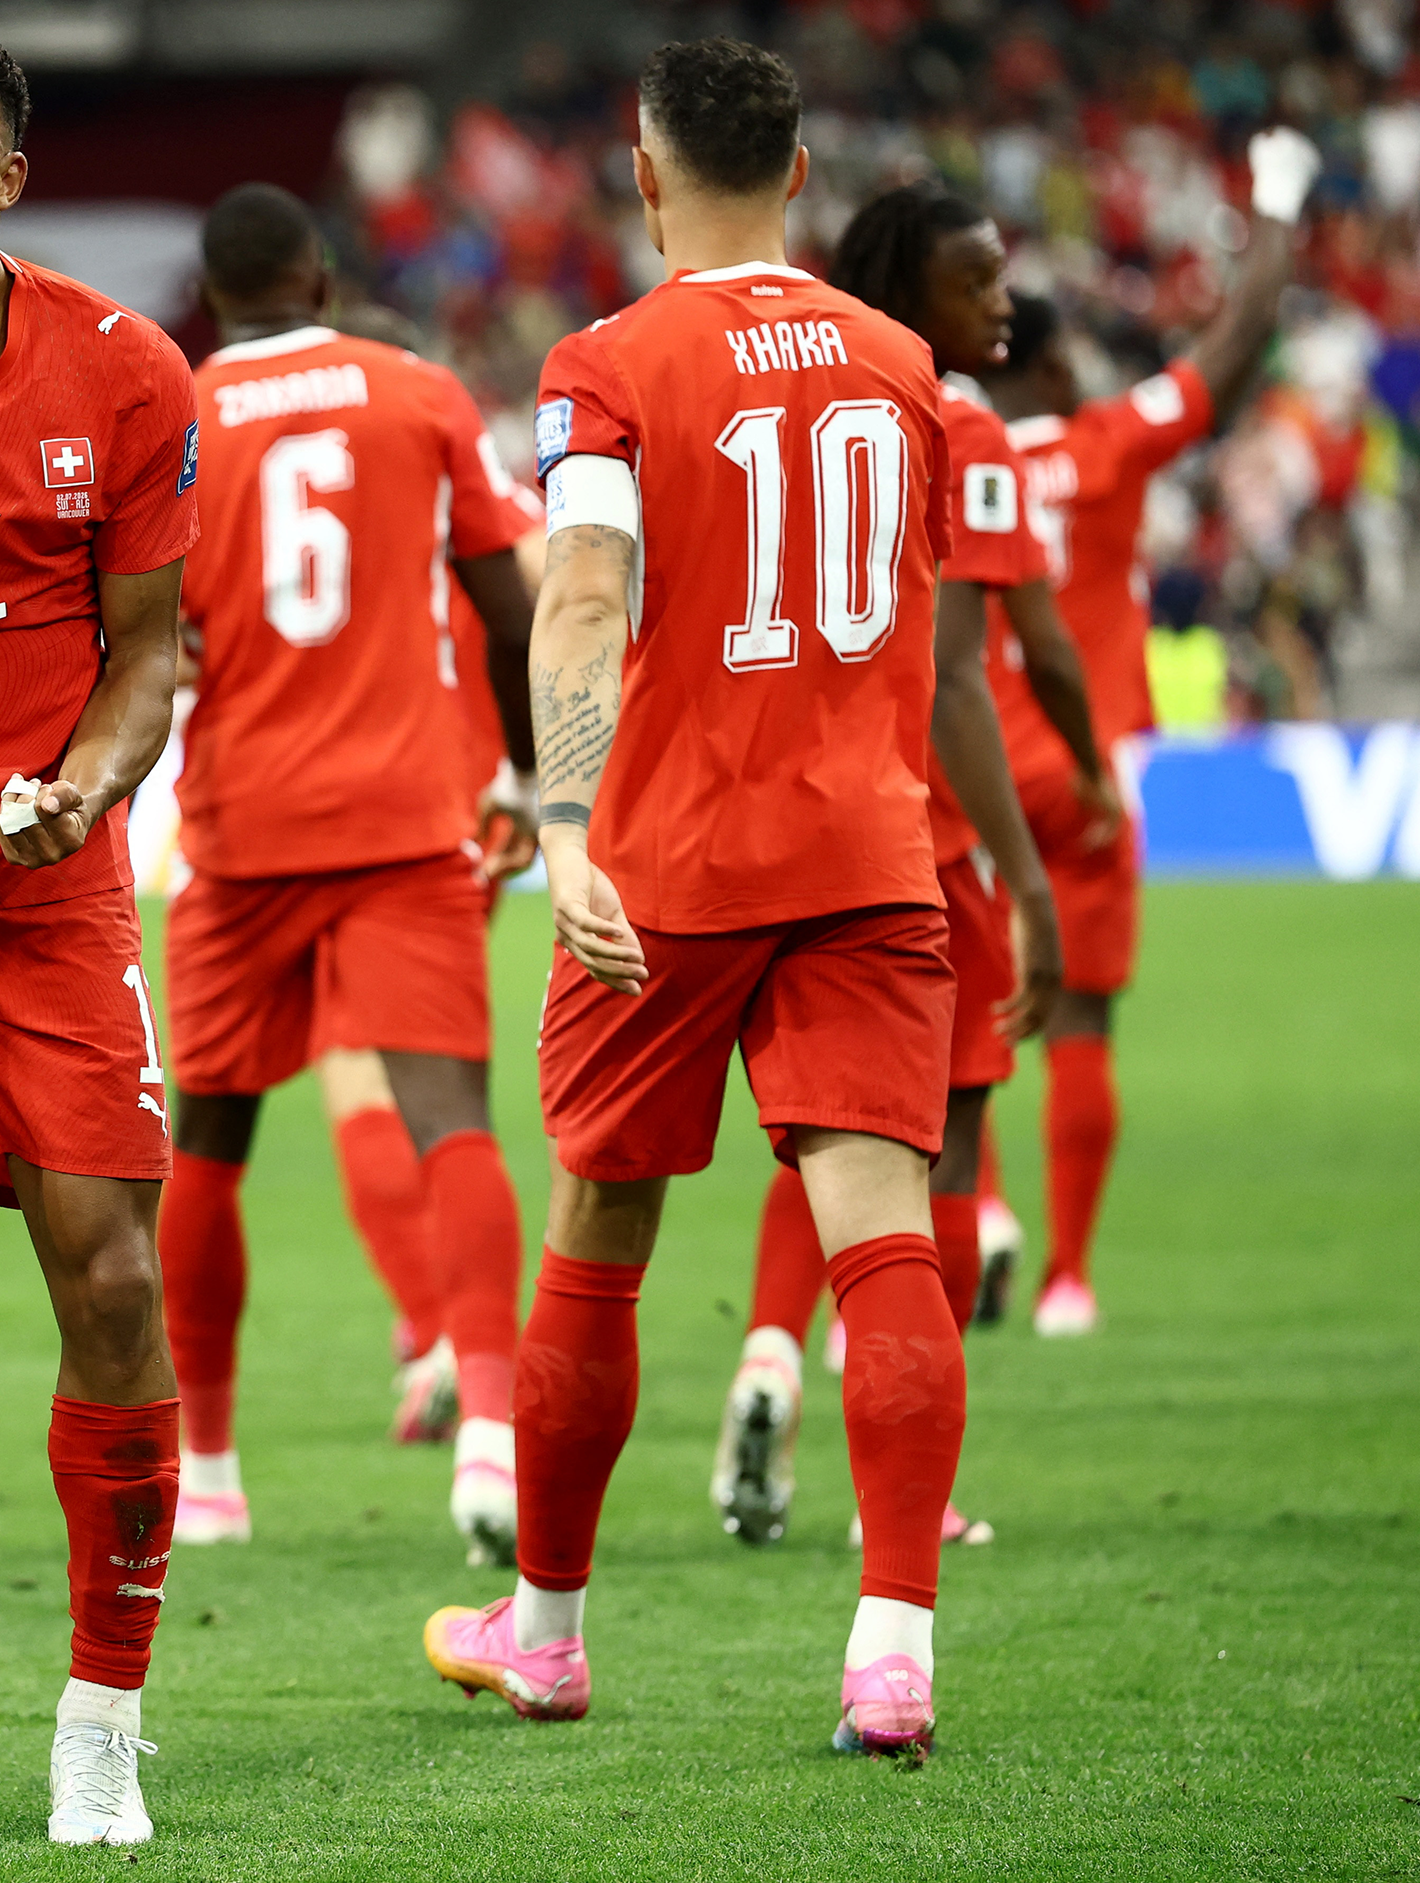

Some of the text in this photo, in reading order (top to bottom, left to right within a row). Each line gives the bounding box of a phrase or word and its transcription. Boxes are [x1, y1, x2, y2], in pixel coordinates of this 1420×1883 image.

[725, 320, 849, 375] XHAKA
[56, 491, 88, 501] 02.07.2026
[56, 499, 69, 511] SUI
[75, 498, 90, 509] ALG
[57, 509, 90, 519] VANCOUVER
[259, 427, 355, 649] 6
[714, 398, 909, 674] 10
